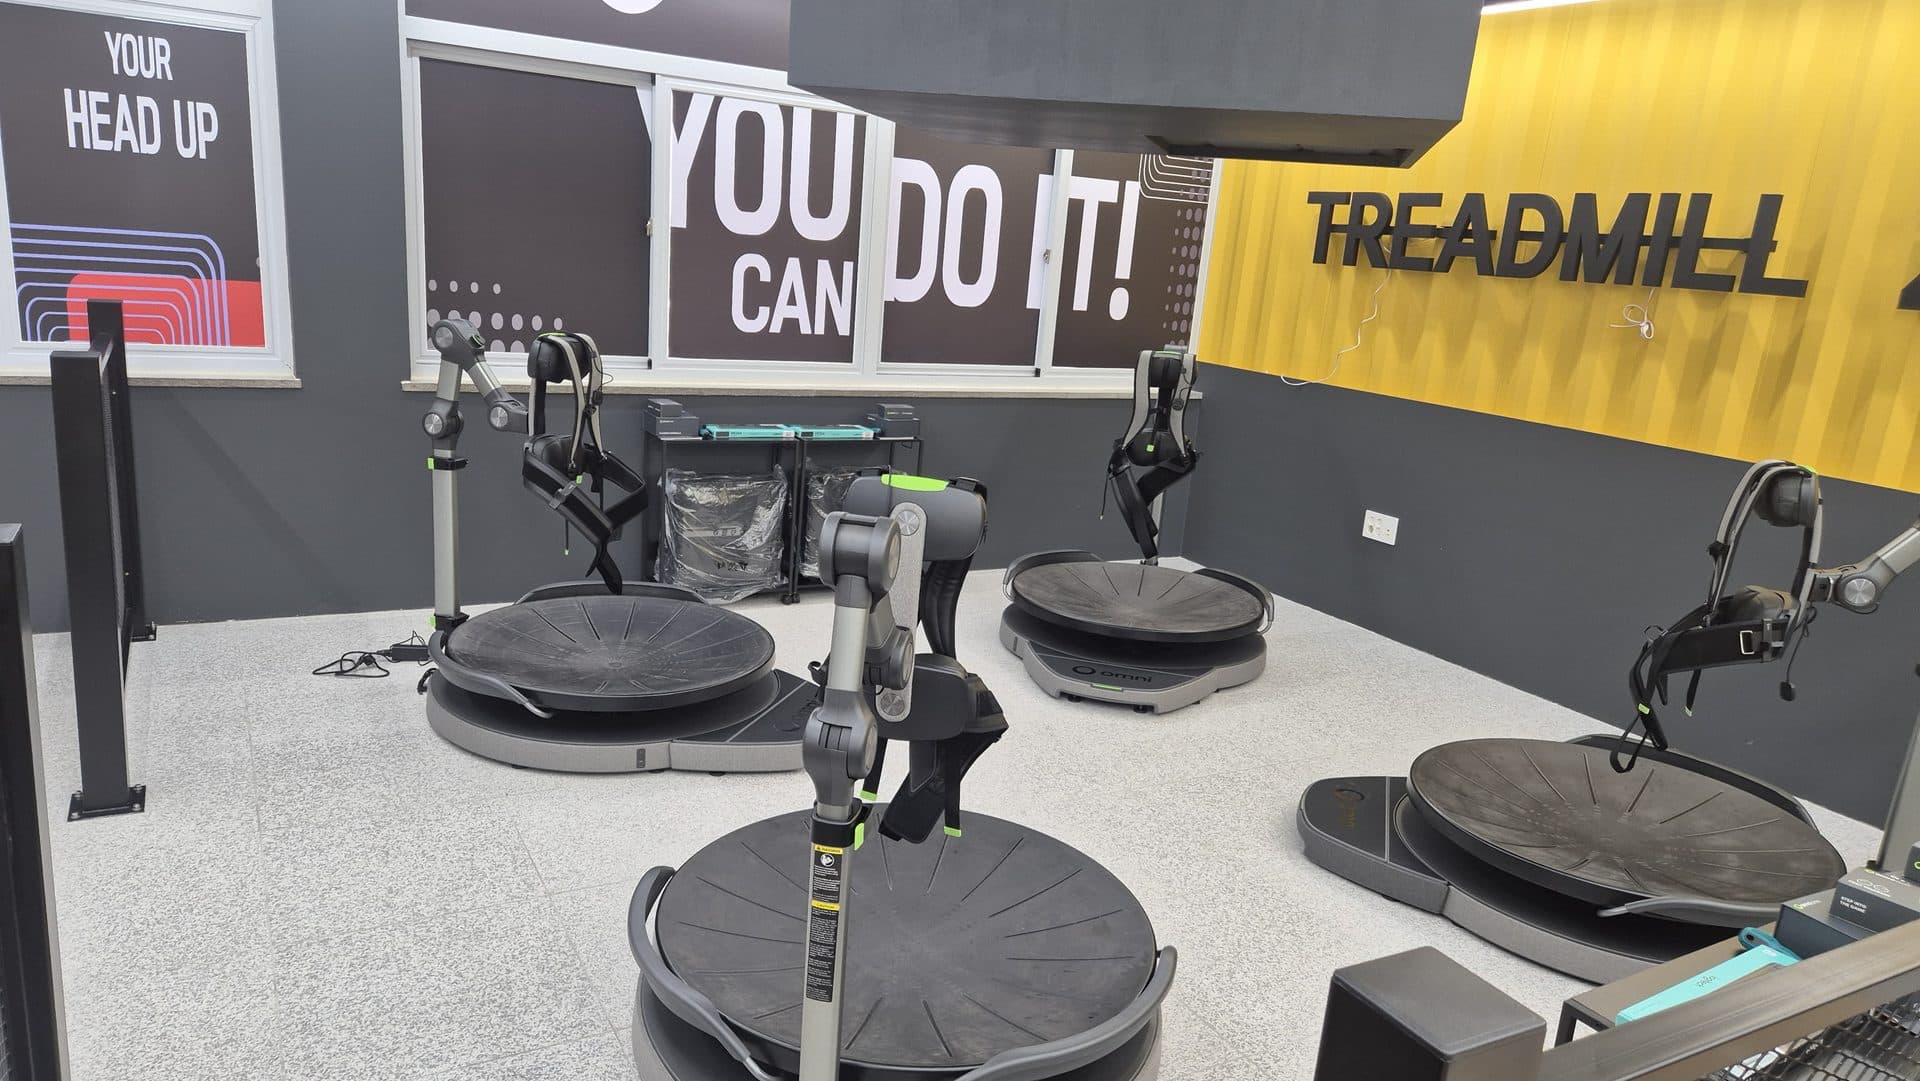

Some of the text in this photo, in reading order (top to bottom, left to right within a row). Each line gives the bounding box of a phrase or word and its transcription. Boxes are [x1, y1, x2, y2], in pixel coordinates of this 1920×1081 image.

[104, 31, 173, 80] YOUR
[64, 88, 219, 159] HEAD UP
[635, 86, 855, 241] YOU
[884, 157, 1140, 320] DO IT!
[1307, 191, 1809, 298] TREADMILL
[731, 253, 854, 336] CAN
[1101, 671, 1152, 683] omni
